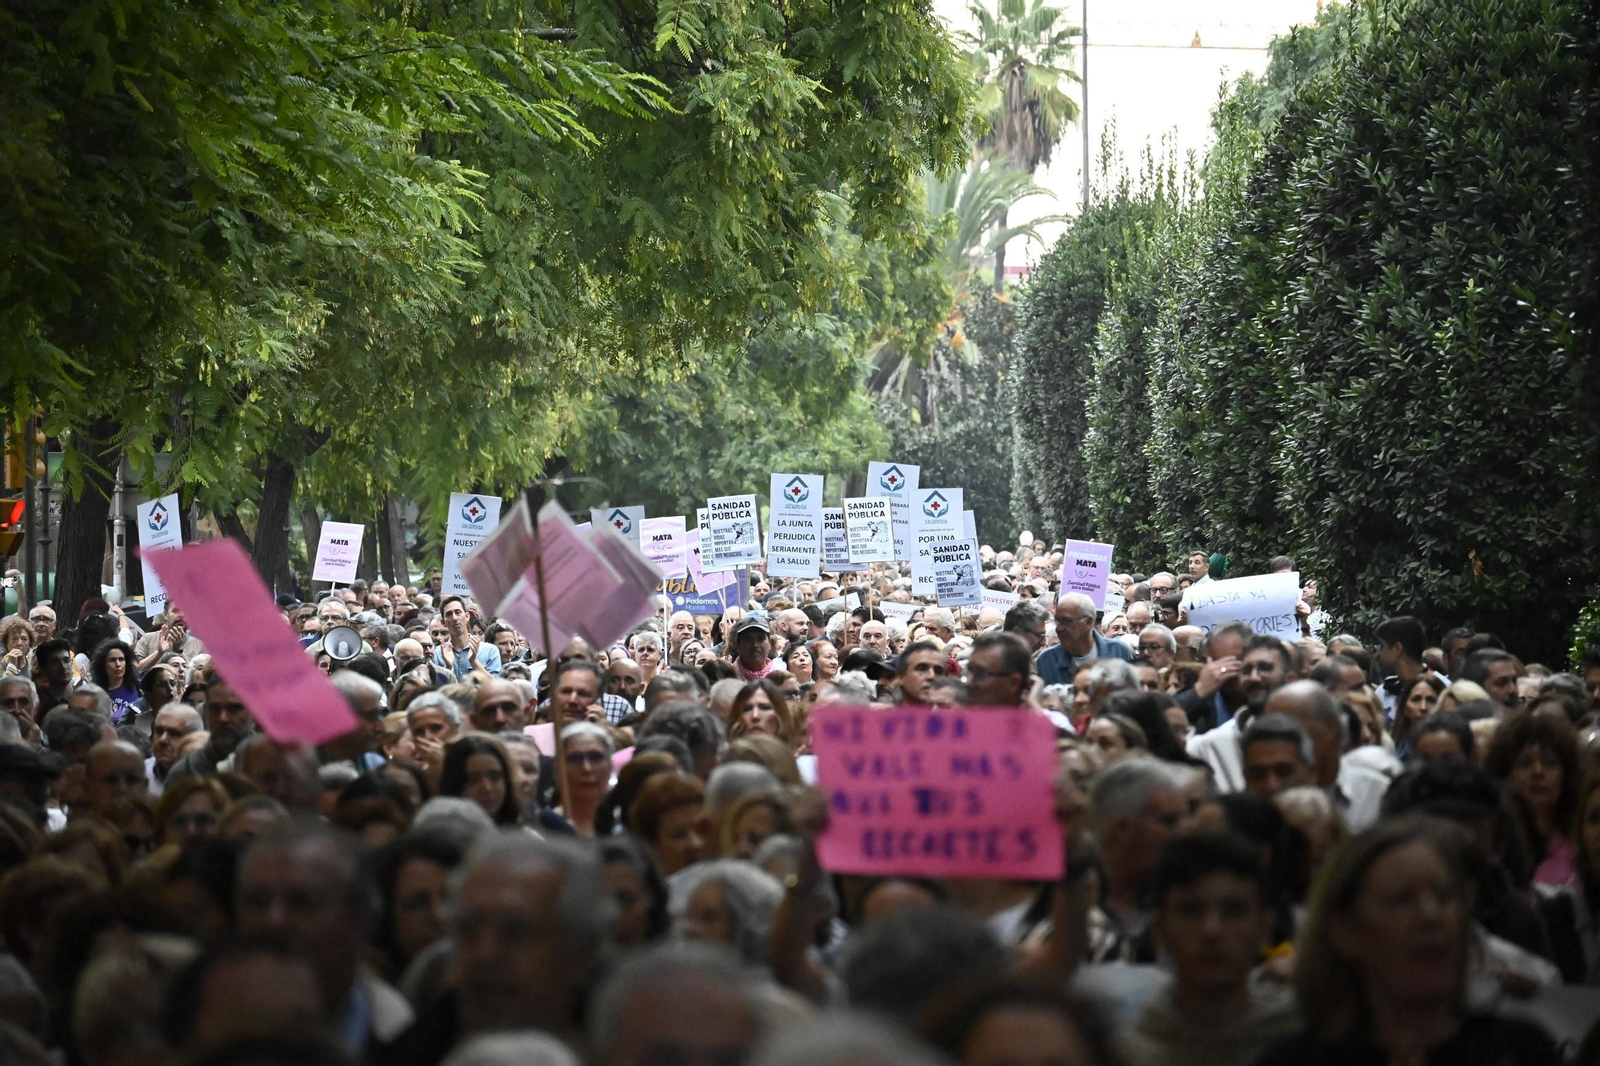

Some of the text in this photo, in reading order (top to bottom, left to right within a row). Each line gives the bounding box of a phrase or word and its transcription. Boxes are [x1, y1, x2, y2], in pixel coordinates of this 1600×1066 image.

[711, 500, 751, 510] SANIDAD
[848, 501, 885, 510] SANIDAD
[712, 510, 752, 520] PÚBLICA
[848, 510, 886, 520] PÚBLICA
[788, 520, 813, 528] JUNTA
[652, 534, 673, 542] MATA
[774, 532, 816, 540] PERJUDICA
[918, 536, 935, 544] POR
[330, 538, 349, 546] MATA
[772, 546, 816, 554] SERIAMENTE
[933, 544, 970, 554] SANIDAD
[788, 558, 810, 566] SALUD
[934, 552, 970, 564] PÚBLICA
[1076, 558, 1097, 568] MATA
[1250, 590, 1267, 600] YA
[983, 596, 1014, 605] SILVESTRE
[823, 713, 968, 743] MI VIDA
[841, 750, 922, 780] VALE
